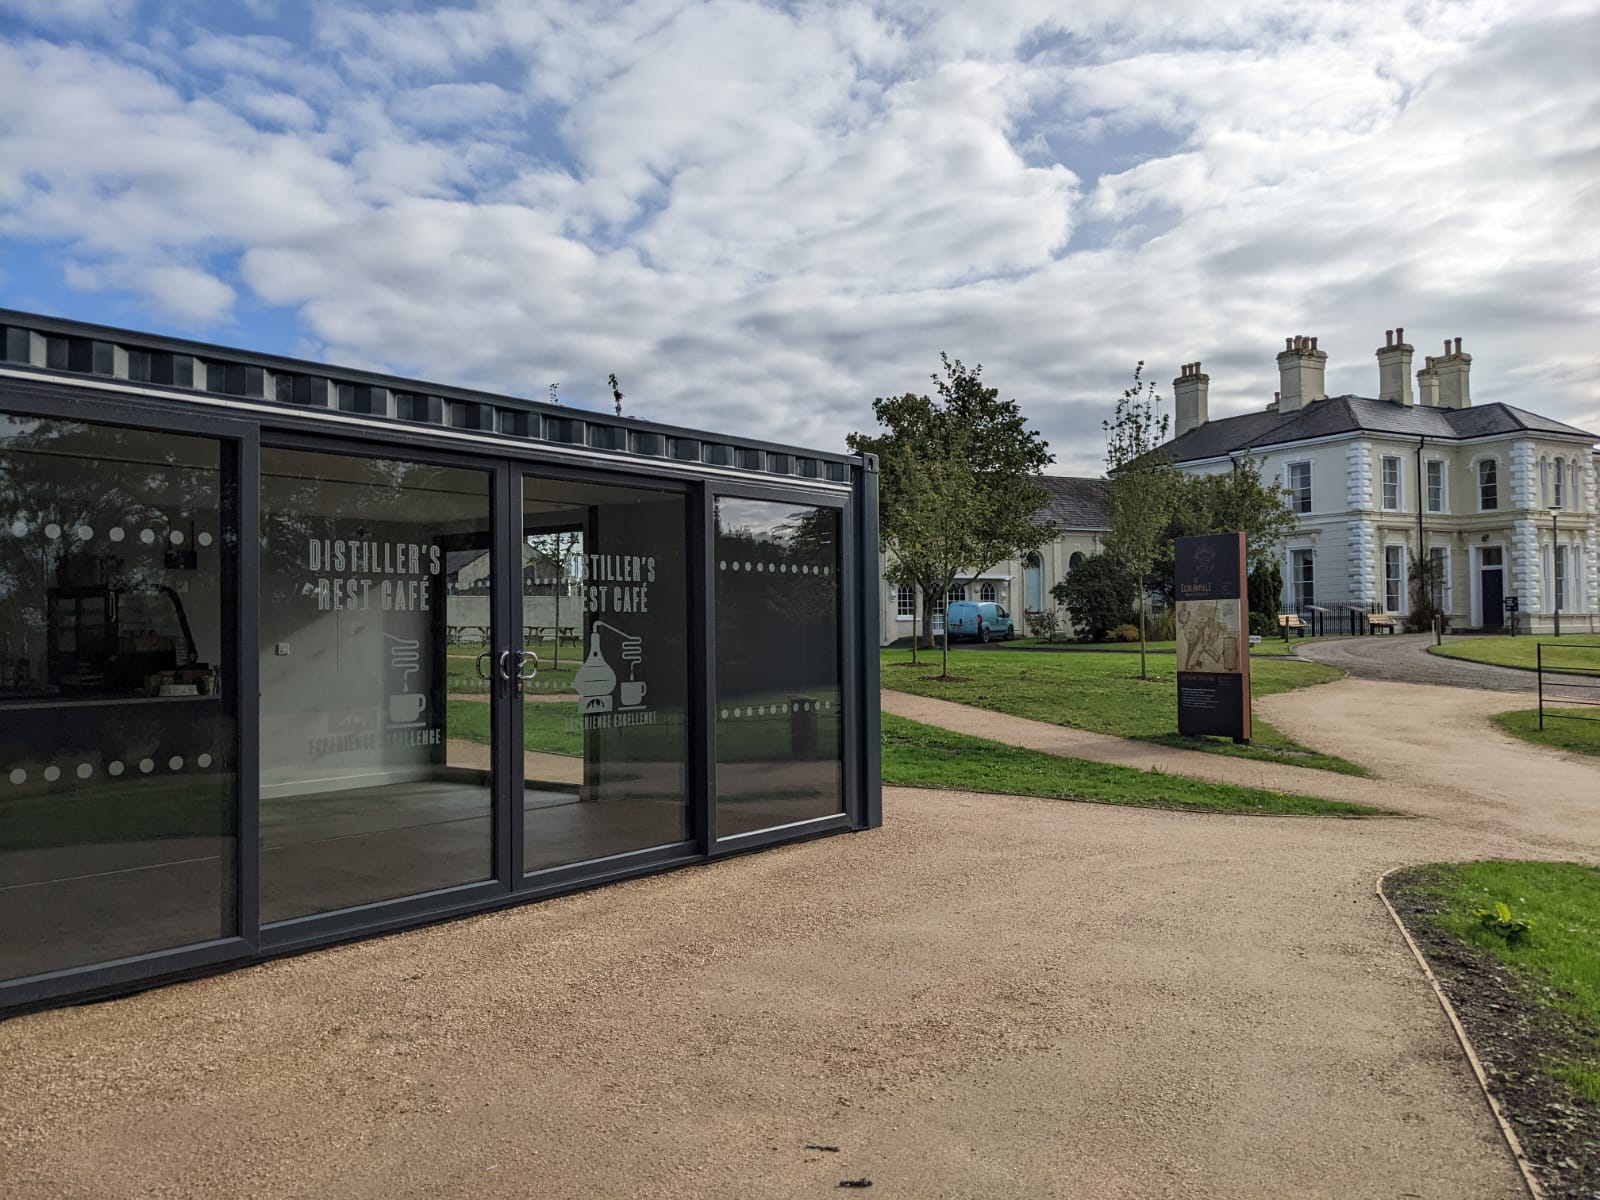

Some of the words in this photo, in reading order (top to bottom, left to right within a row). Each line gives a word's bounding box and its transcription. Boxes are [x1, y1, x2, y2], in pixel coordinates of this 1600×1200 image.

[309, 538, 441, 575] DISTILLER'S
[318, 578, 372, 611] REST
[381, 575, 430, 611] CAFÉ
[613, 582, 648, 612] CAFÉ
[379, 728, 441, 750] XCELLENCE
